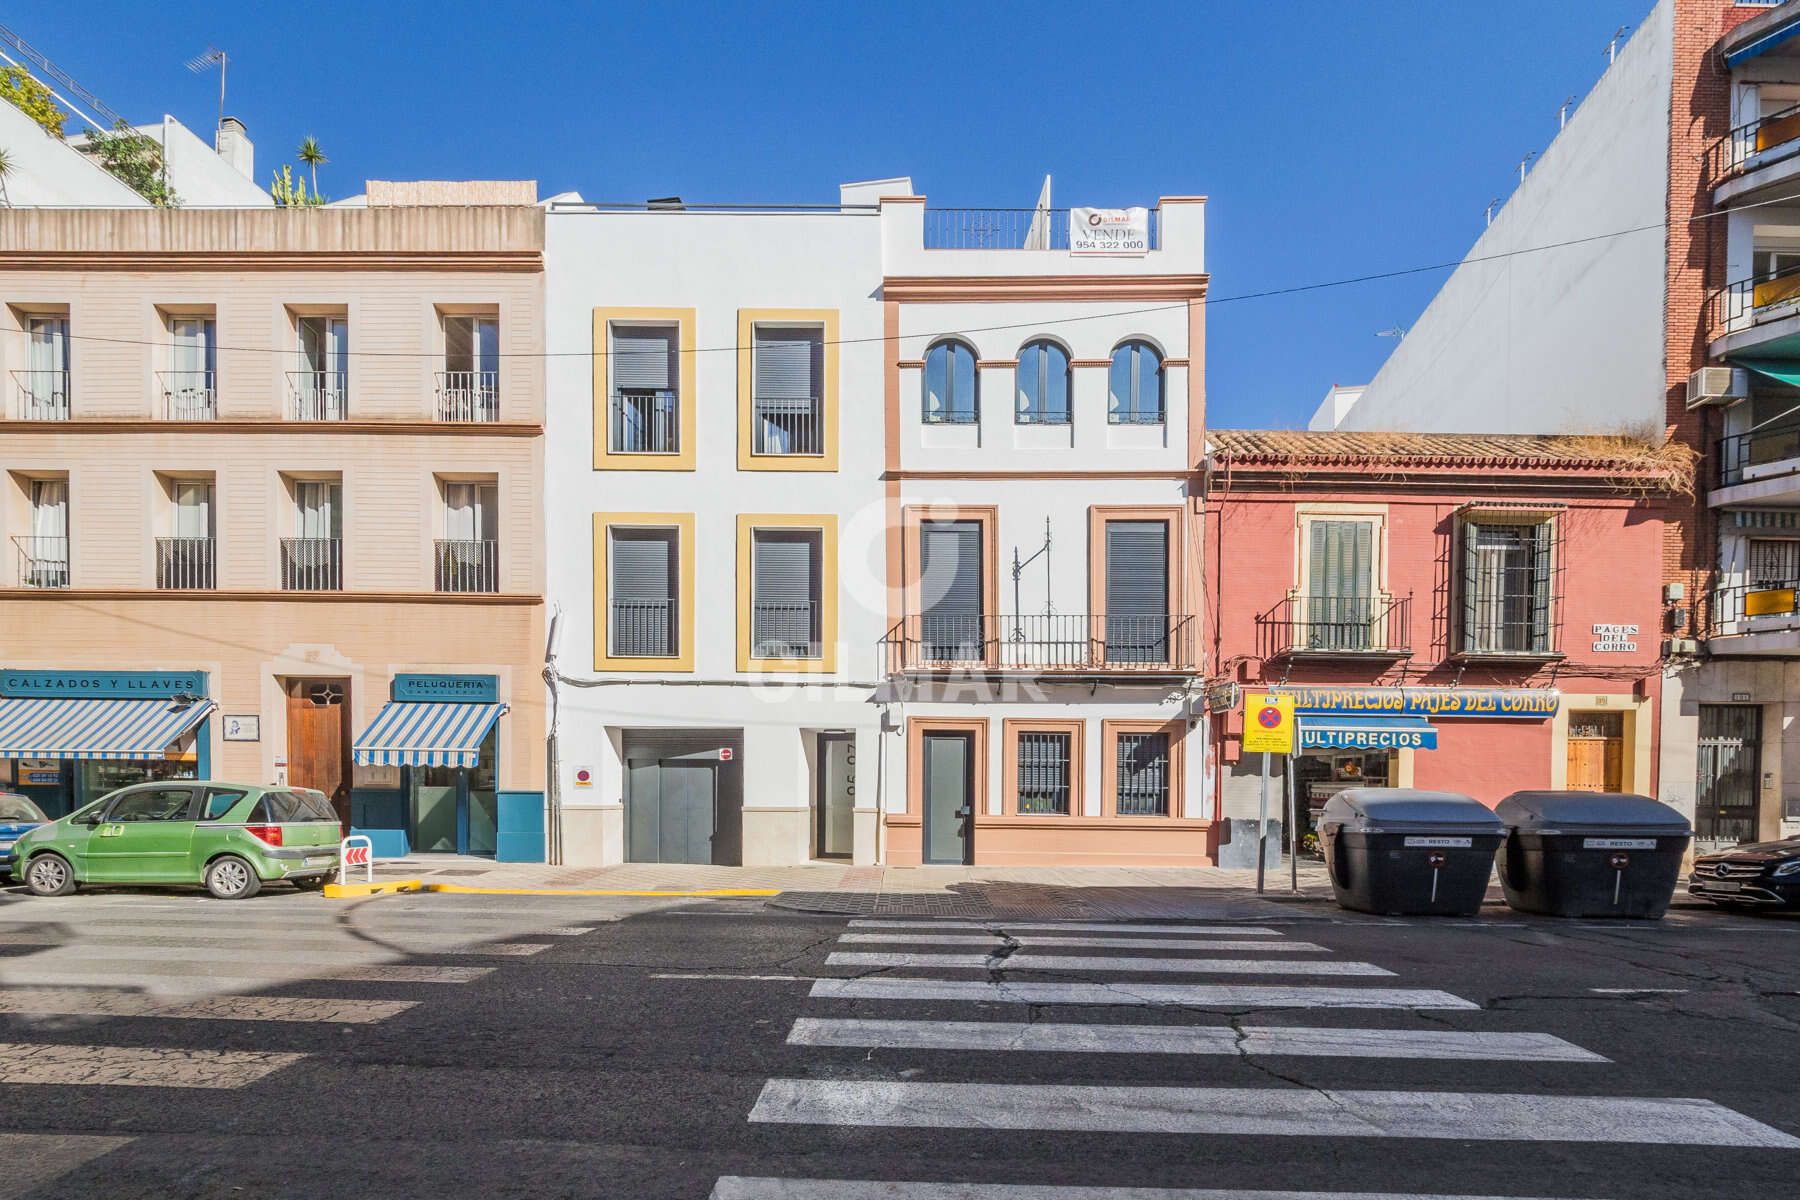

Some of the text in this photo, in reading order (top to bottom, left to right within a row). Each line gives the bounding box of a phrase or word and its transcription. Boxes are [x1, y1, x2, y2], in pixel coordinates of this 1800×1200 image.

[1082, 229, 1135, 240] VENDE
[1595, 625, 1637, 633] PAGES
[9, 679, 194, 689] CALZADOS Y LLAVES
[1410, 692, 1461, 713] PAJES
[1464, 692, 1497, 711] DEL
[1501, 692, 1558, 711] CORRO
[1299, 731, 1421, 746] ULTIPRECIOS
